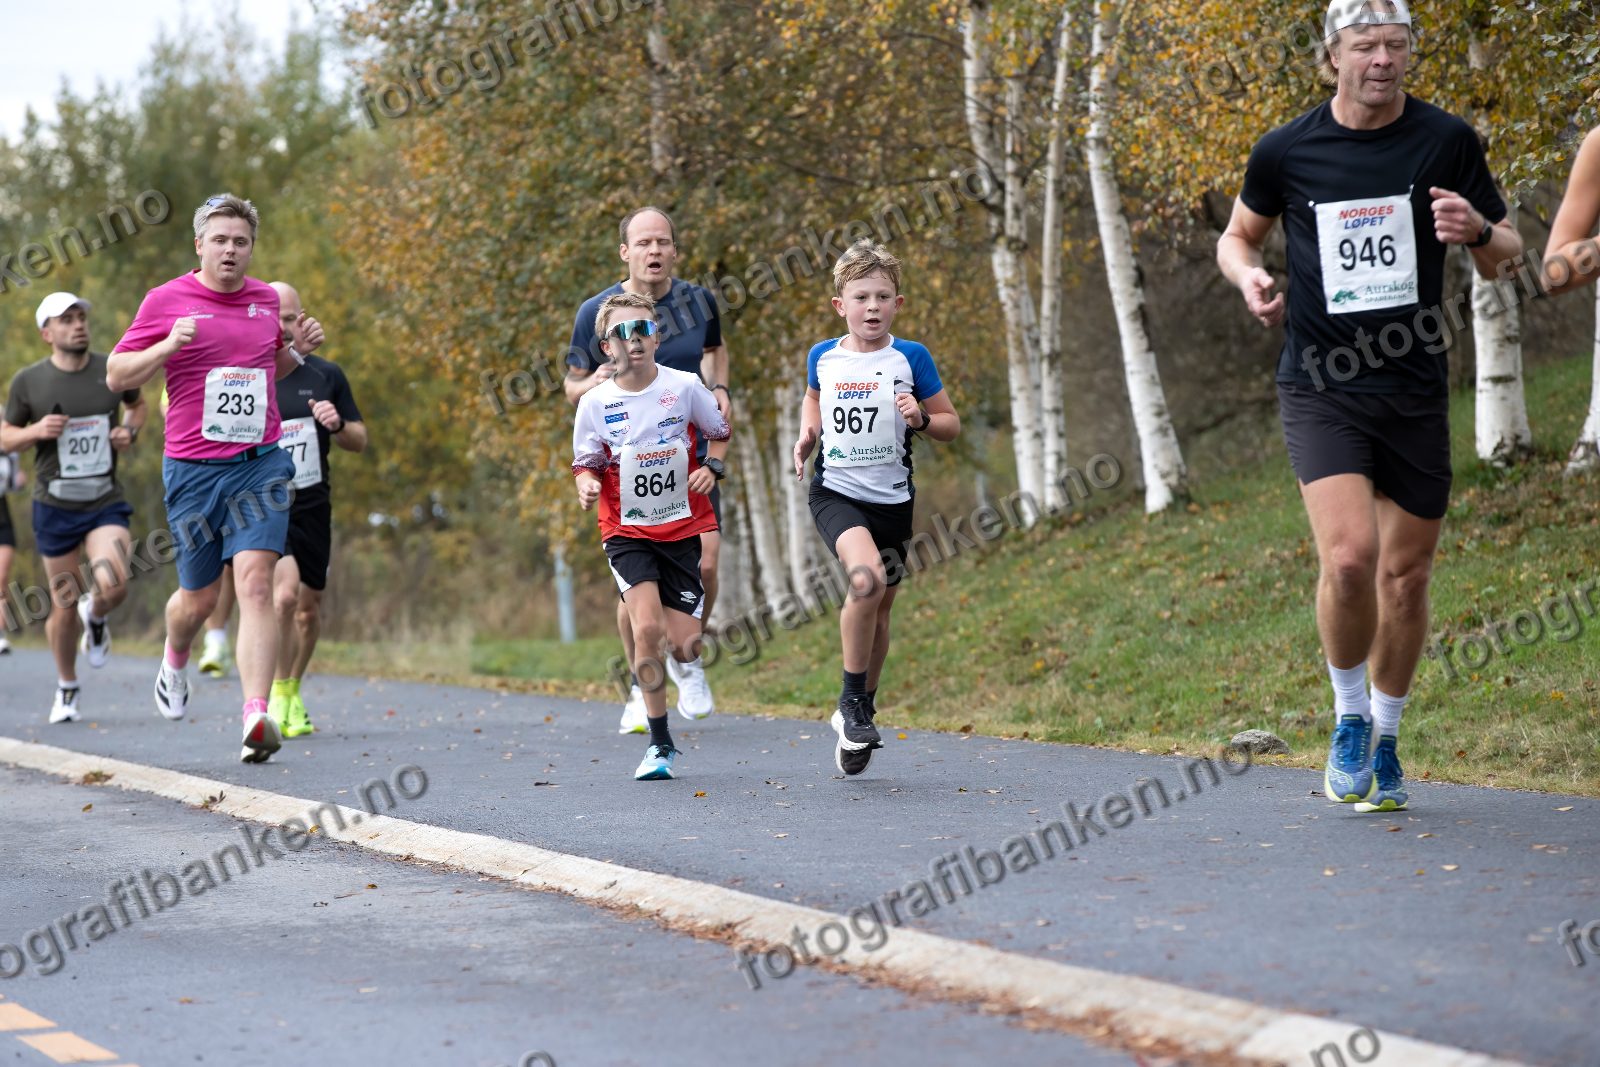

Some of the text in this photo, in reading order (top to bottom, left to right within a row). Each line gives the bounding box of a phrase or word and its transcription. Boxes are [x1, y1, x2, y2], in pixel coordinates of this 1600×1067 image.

[1339, 205, 1394, 220] NORGES
[1344, 216, 1386, 230] LØPET
[1339, 235, 1397, 271] 946
[1365, 281, 1415, 297] Aurskog
[222, 372, 257, 381] NORGES
[224, 379, 251, 387] LØPET
[833, 382, 879, 391] NORGES
[837, 390, 872, 399] LØPET
[216, 392, 255, 416] 233
[833, 406, 879, 434] 967
[69, 435, 99, 455] 207
[849, 445, 893, 456] Aurskog
[633, 448, 678, 461] NORGES
[634, 470, 676, 497] 864
[651, 500, 687, 516] Aurskog
